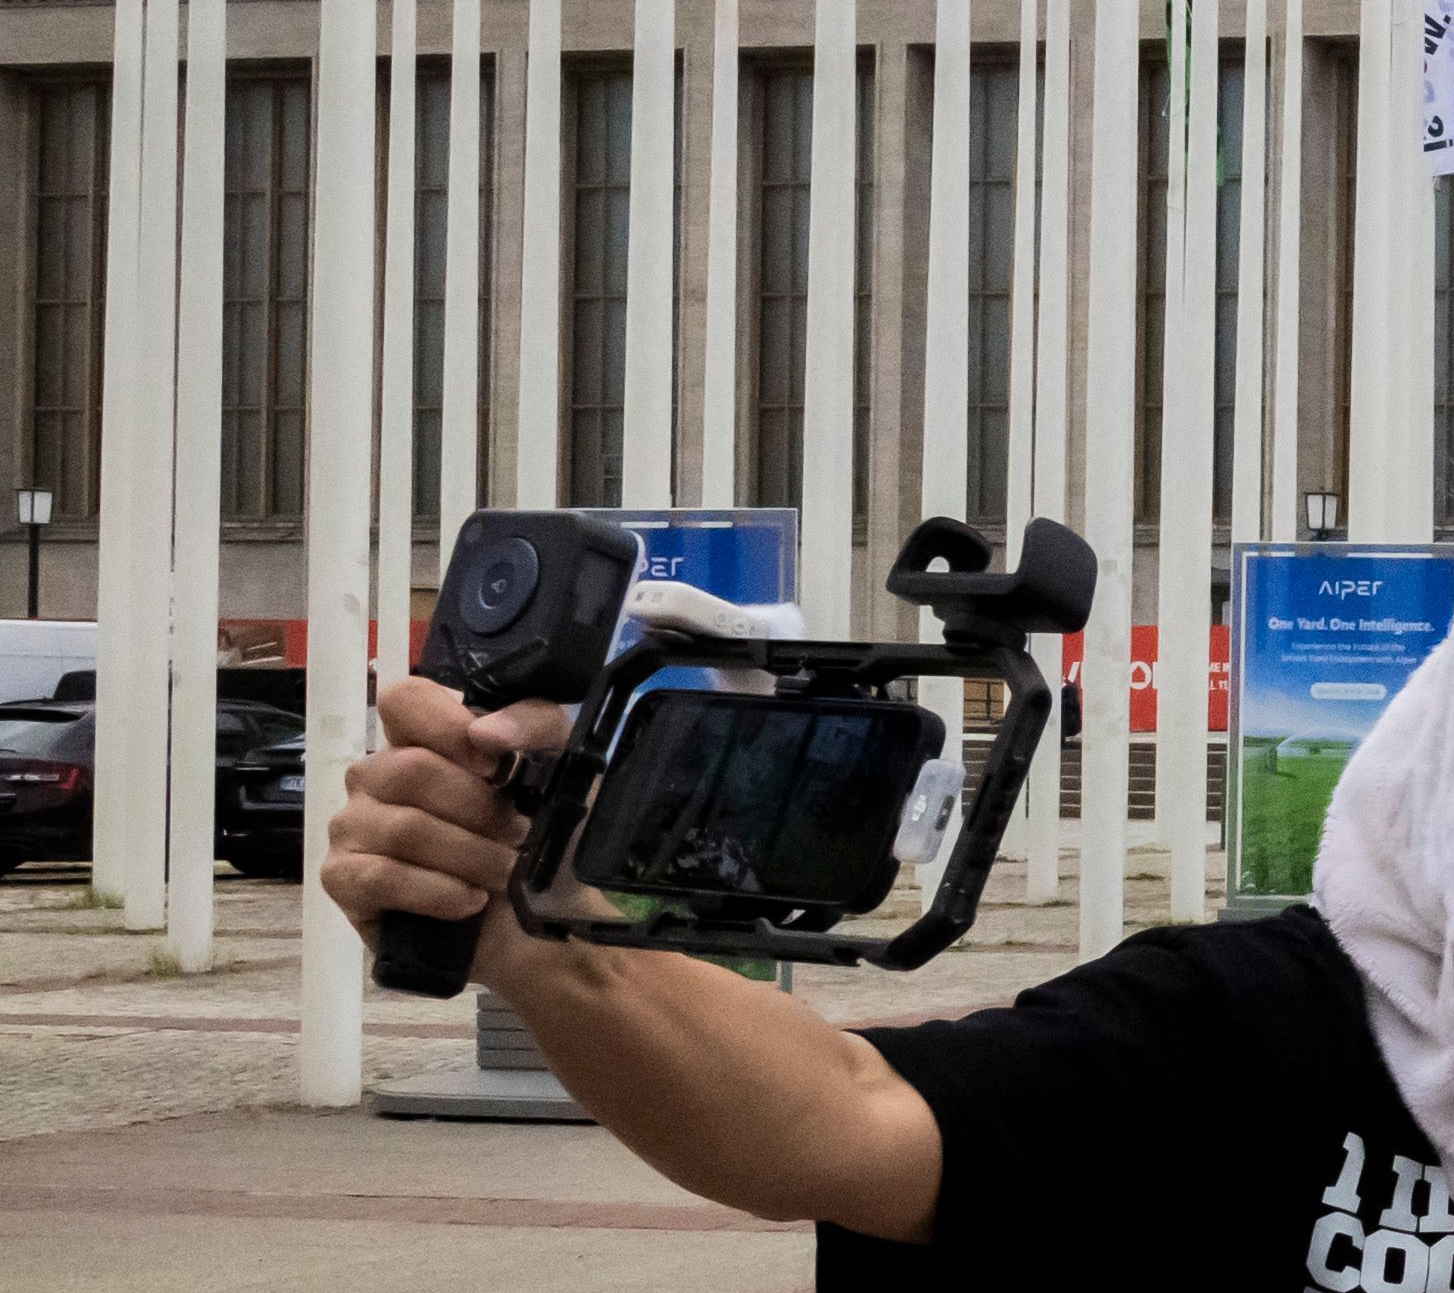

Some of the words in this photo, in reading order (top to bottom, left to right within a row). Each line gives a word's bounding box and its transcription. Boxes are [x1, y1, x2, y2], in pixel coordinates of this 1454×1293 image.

[1268, 617, 1294, 631] One
[1296, 617, 1328, 631] Yard.
[1330, 618, 1356, 631] One
[1359, 618, 1436, 635] Intelligence.
